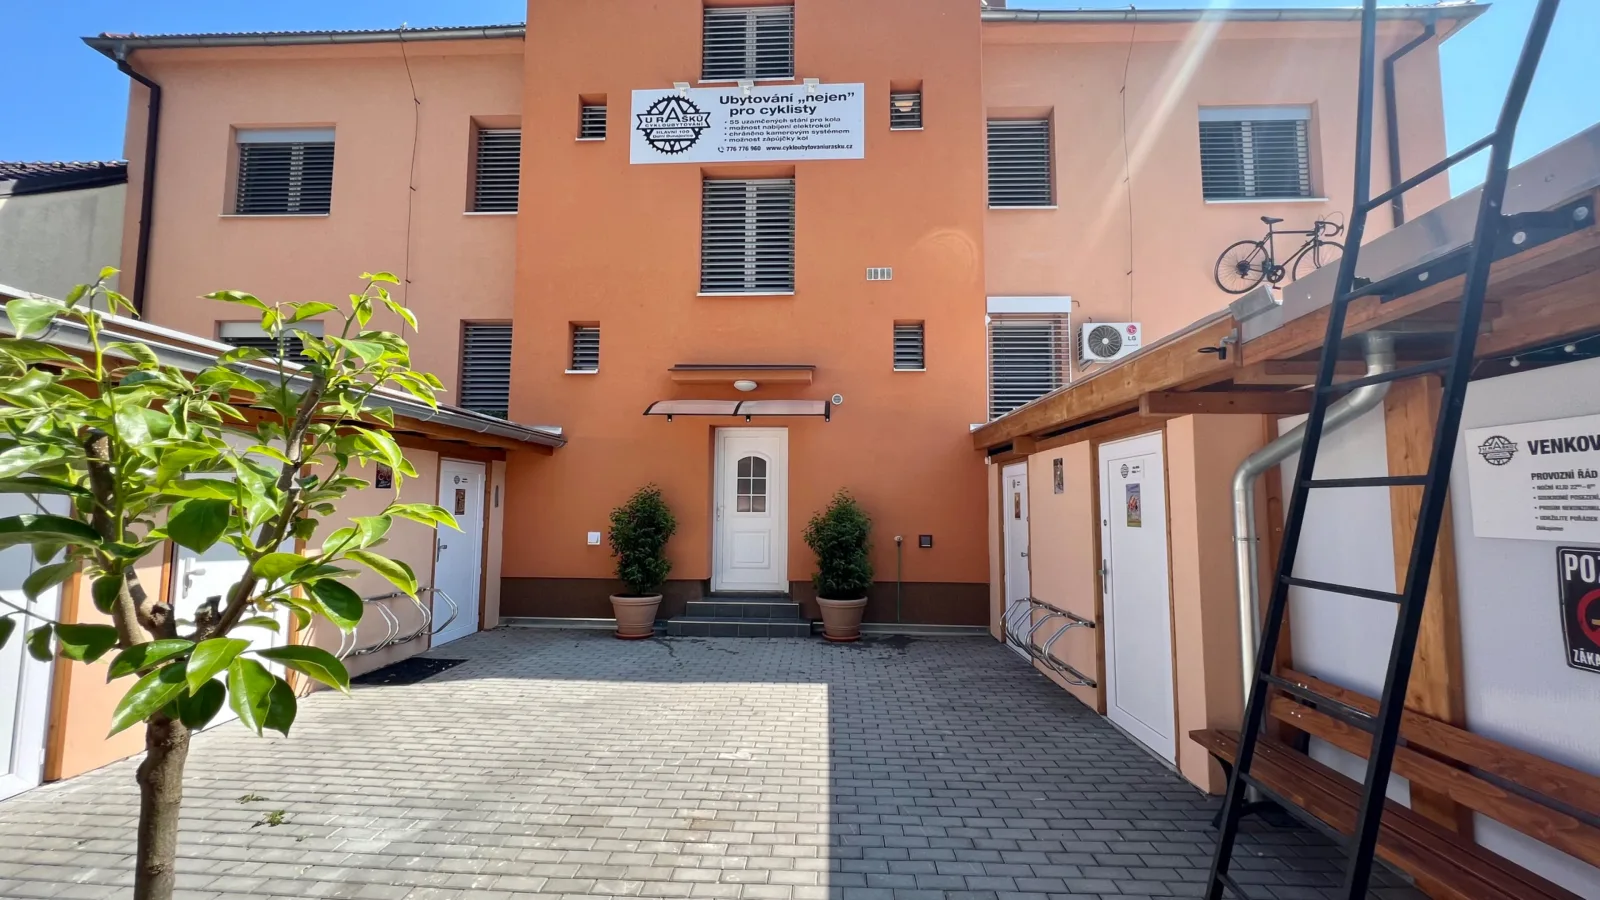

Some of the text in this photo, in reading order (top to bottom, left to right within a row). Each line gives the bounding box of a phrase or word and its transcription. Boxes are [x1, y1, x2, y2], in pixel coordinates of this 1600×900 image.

[720, 93, 793, 106] Ubytování
[730, 104, 817, 117] pro cyklisty
[1527, 434, 1600, 455] VENKOV
[1531, 468, 1598, 480] PROVOZNÍ ŘÁD
[1564, 553, 1600, 584] PO
